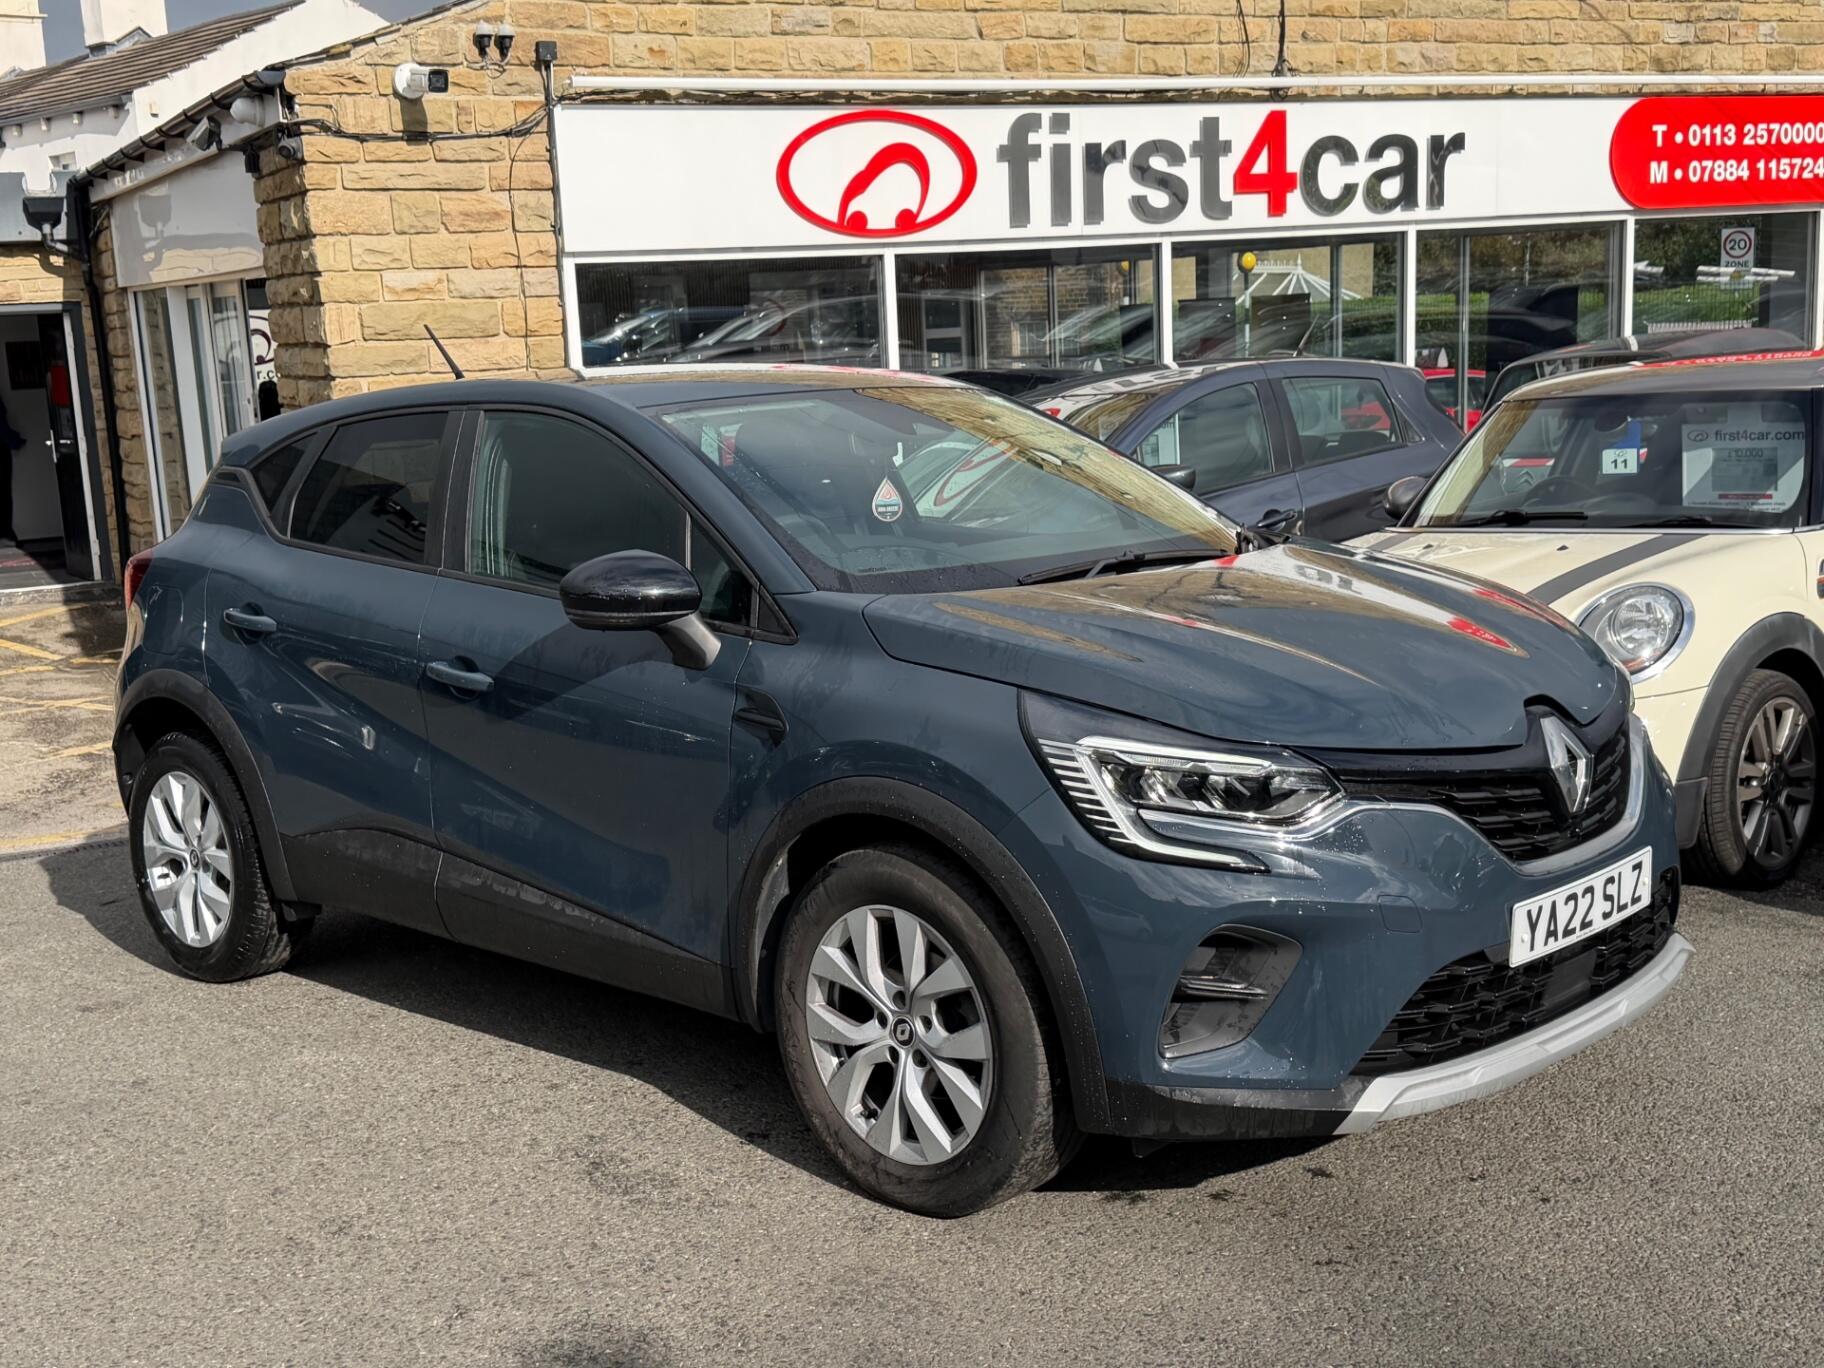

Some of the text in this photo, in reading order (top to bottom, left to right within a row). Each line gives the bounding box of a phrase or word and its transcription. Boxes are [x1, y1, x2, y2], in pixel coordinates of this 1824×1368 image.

[1688, 123, 1737, 147] 0113
[1742, 121, 1824, 146] 2570000
[996, 109, 1466, 229] first4car
[1688, 158, 1749, 183] 07884
[1756, 156, 1824, 181] 115724
[1728, 238, 1747, 251] 20
[1724, 260, 1750, 268] ZONE
[1714, 429, 1805, 441] first4car.com
[1610, 459, 1628, 470] 11
[1526, 860, 1643, 952] YA22 SLZ
